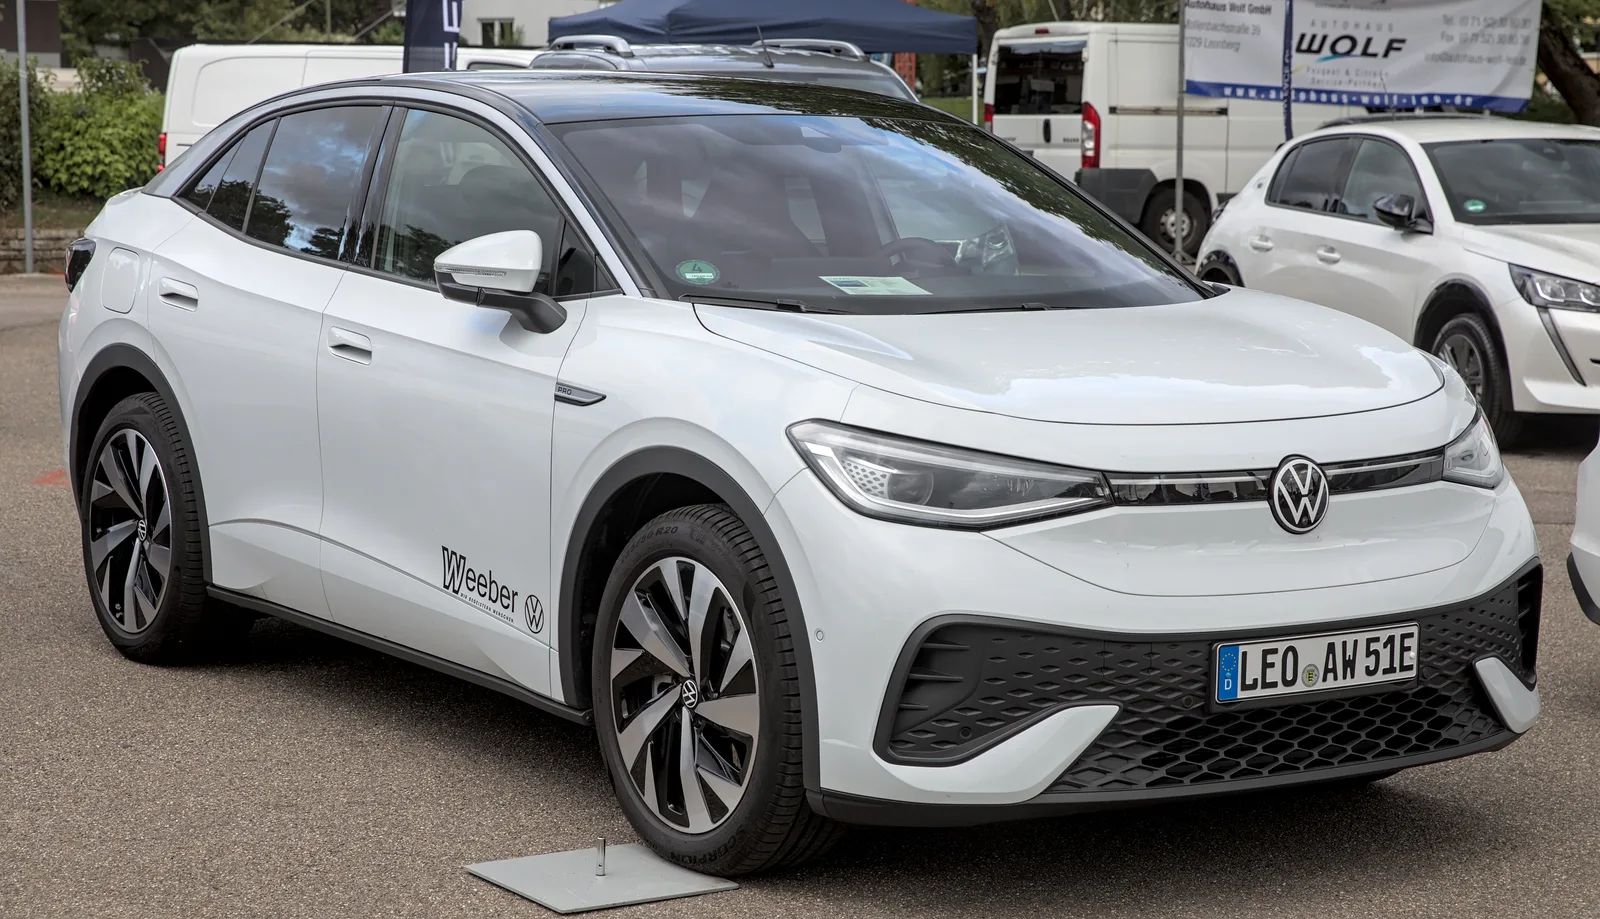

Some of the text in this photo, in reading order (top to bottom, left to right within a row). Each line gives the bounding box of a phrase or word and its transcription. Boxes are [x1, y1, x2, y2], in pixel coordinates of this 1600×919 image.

[1310, 19, 1394, 32] AUTOHAUS
[1295, 32, 1407, 58] WOLF
[557, 386, 572, 396] PRO
[441, 545, 518, 613] Weeber
[1240, 632, 1415, 691] LEO AW 51E
[1224, 678, 1232, 690] D
